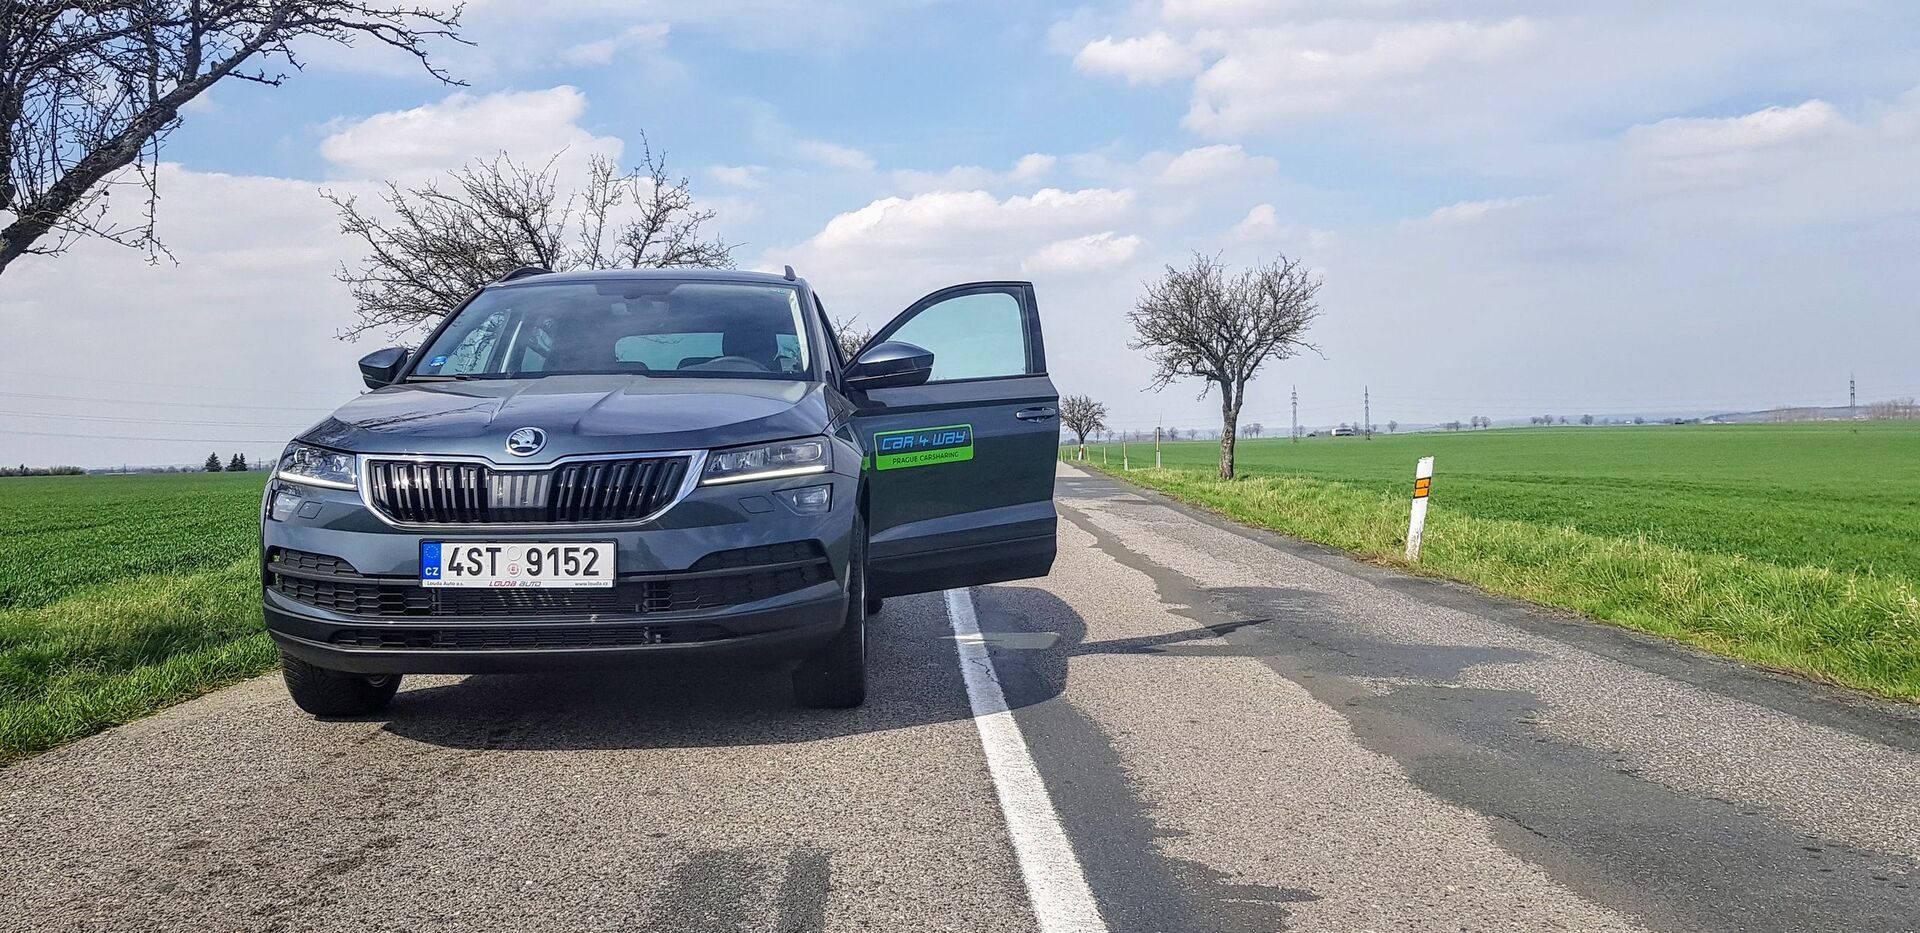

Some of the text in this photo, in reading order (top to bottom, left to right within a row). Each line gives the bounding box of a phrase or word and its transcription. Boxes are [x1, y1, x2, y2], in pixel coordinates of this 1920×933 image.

[919, 433, 929, 447] 4
[892, 451, 959, 465] PRAGUE CARSHARING
[448, 547, 599, 576] 4ST 9152
[425, 567, 439, 576] CZ
